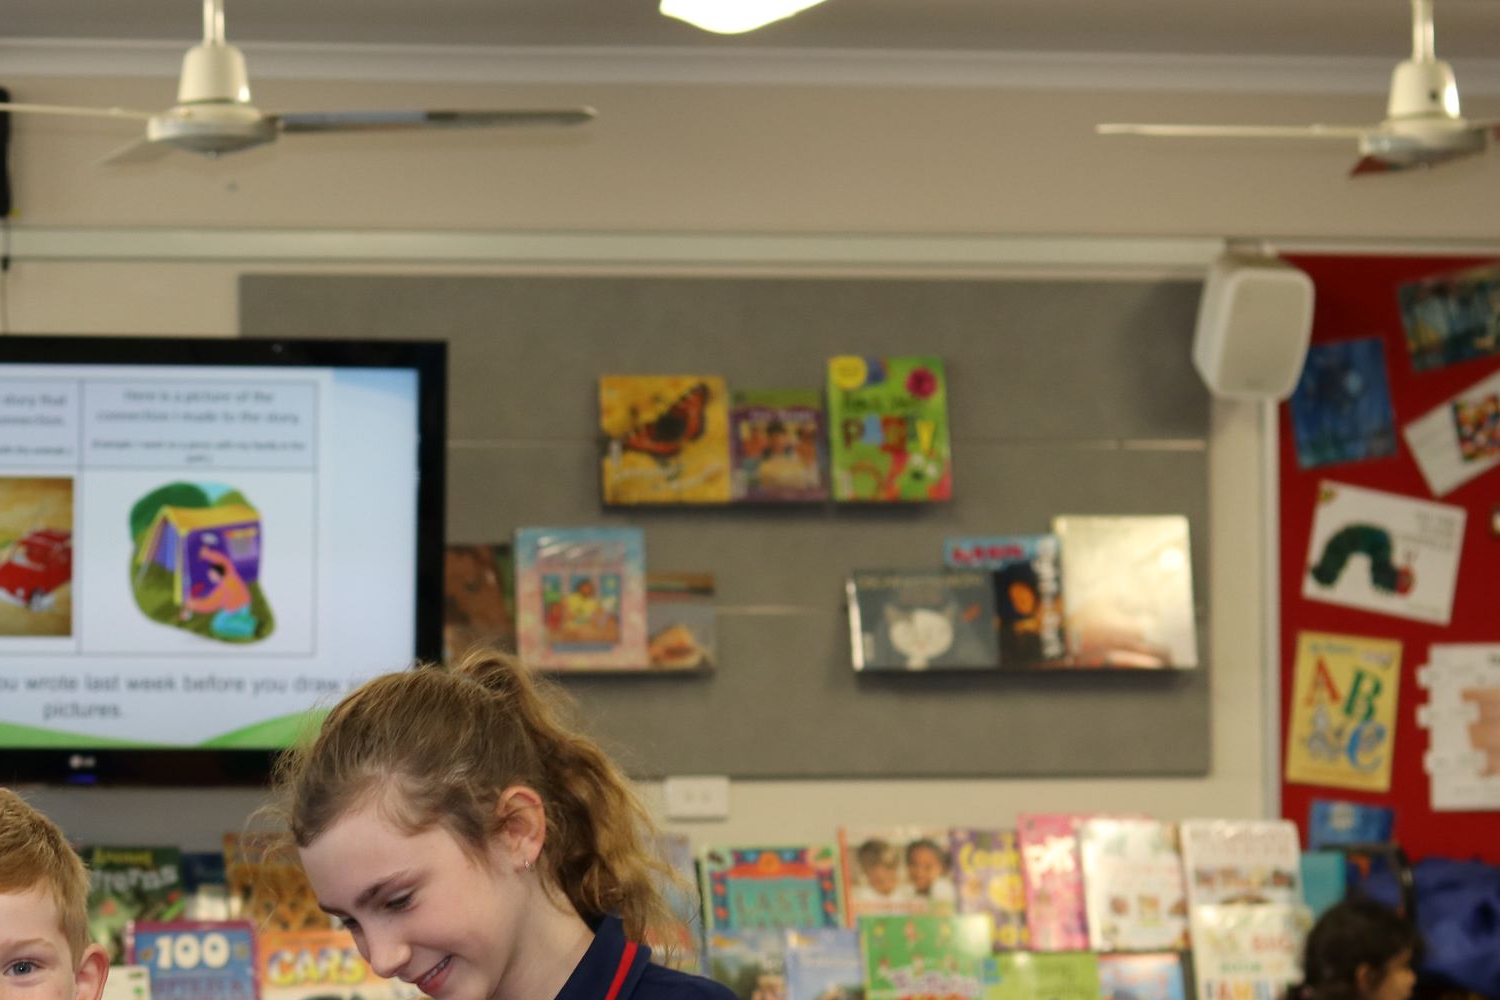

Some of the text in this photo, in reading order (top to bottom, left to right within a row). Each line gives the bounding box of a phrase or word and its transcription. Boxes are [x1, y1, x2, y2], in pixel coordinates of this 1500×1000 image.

[25, 673, 78, 692] wrote
[84, 673, 121, 692] last
[126, 672, 175, 692] week
[183, 672, 251, 692] before
[253, 677, 287, 697] you
[292, 673, 341, 693] draw
[155, 932, 231, 970] 100
[268, 949, 366, 986] CARS
